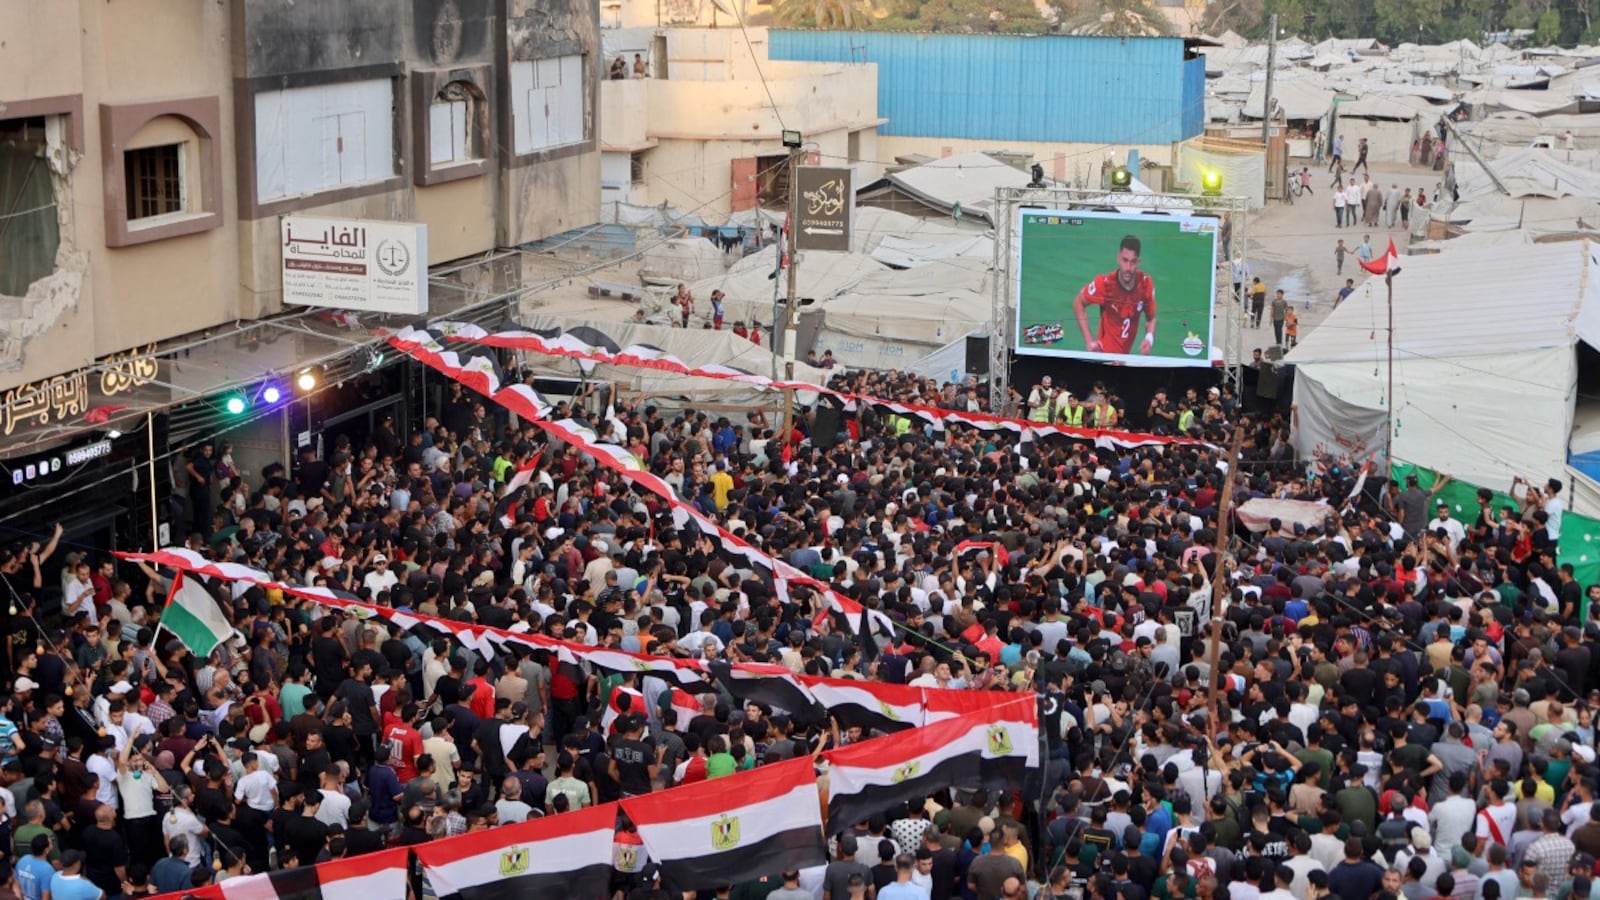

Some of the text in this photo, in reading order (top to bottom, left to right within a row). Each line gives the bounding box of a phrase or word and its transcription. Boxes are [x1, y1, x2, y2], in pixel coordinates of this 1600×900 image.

[284, 222, 366, 249] الفايز
[290, 244, 365, 260] للمحاماة
[1121, 318, 1130, 338] 2
[847, 341, 864, 350] IOM
[886, 346, 904, 355] IOM
